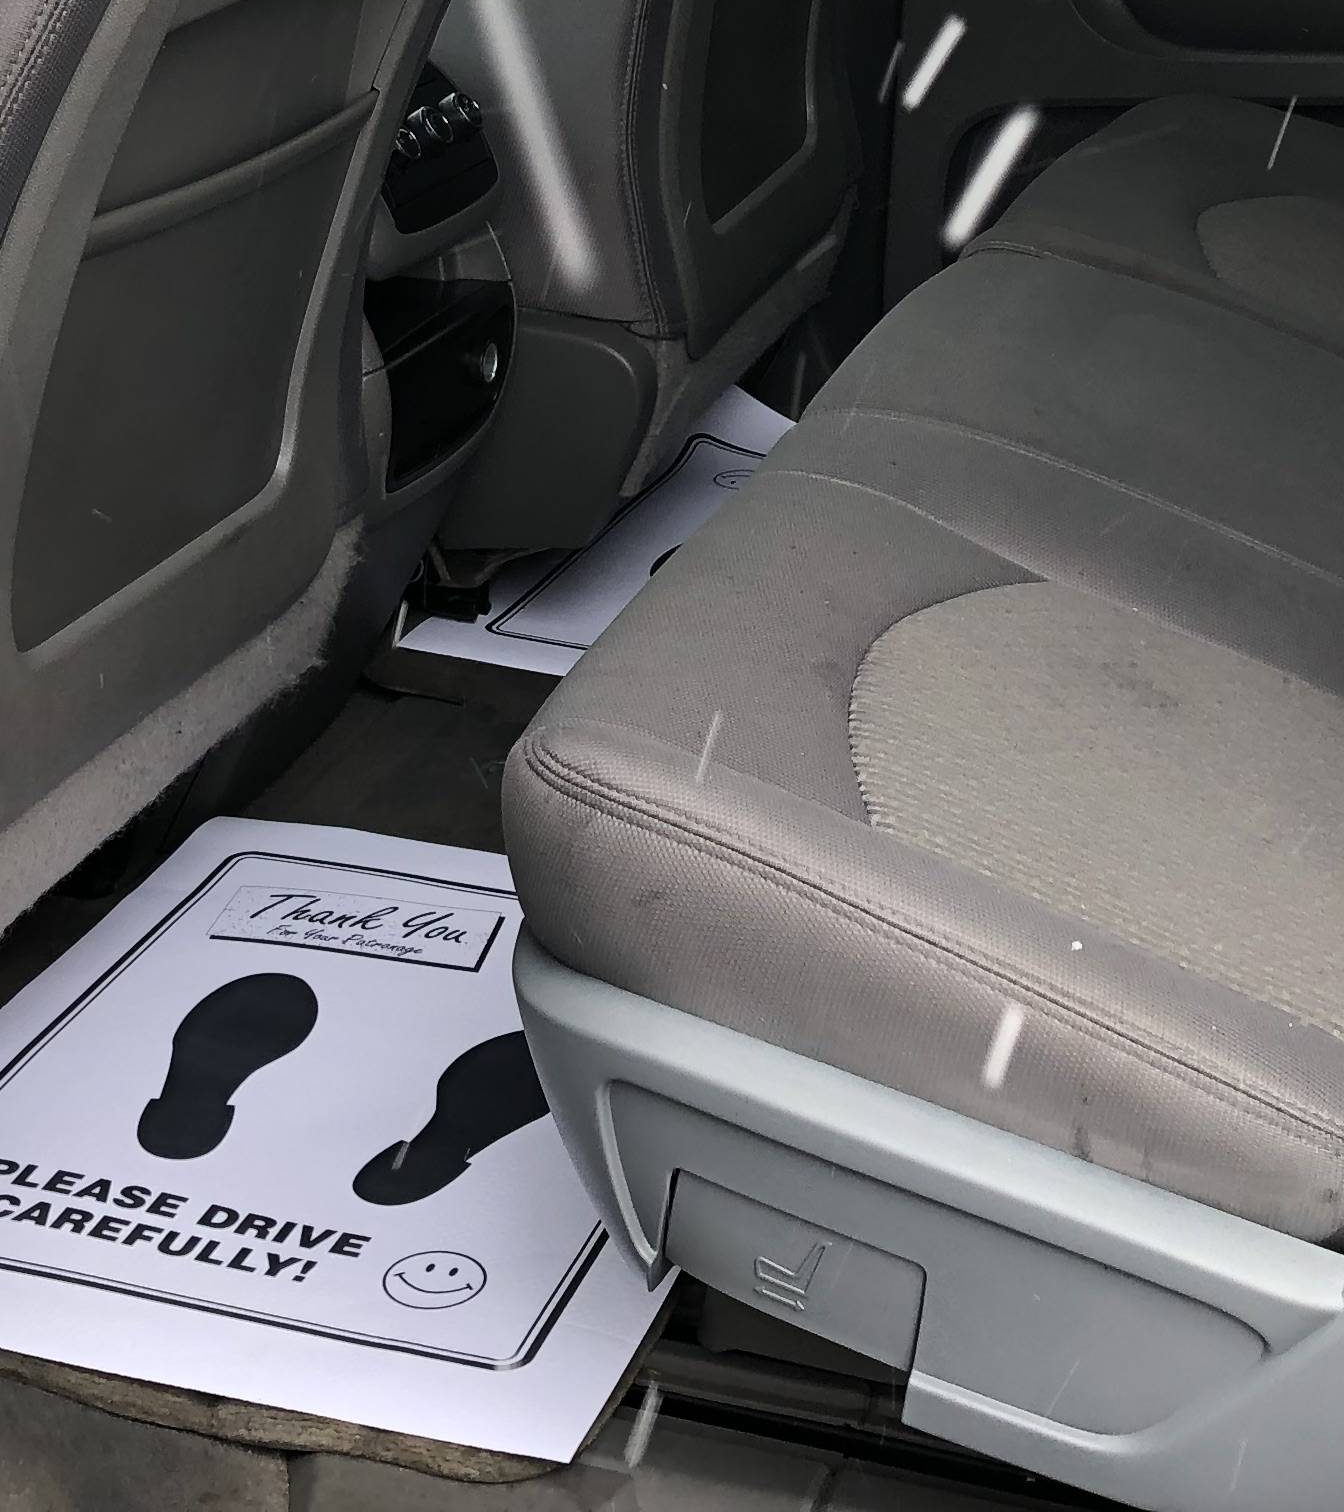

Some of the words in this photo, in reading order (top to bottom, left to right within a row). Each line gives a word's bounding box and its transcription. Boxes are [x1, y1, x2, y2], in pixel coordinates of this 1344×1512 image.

[250, 894, 399, 930] Thank
[402, 911, 468, 944] You
[266, 924, 298, 936] For
[304, 928, 339, 942] Your
[342, 933, 424, 956] Patronage
[196, 1204, 372, 1257] DRIVE
